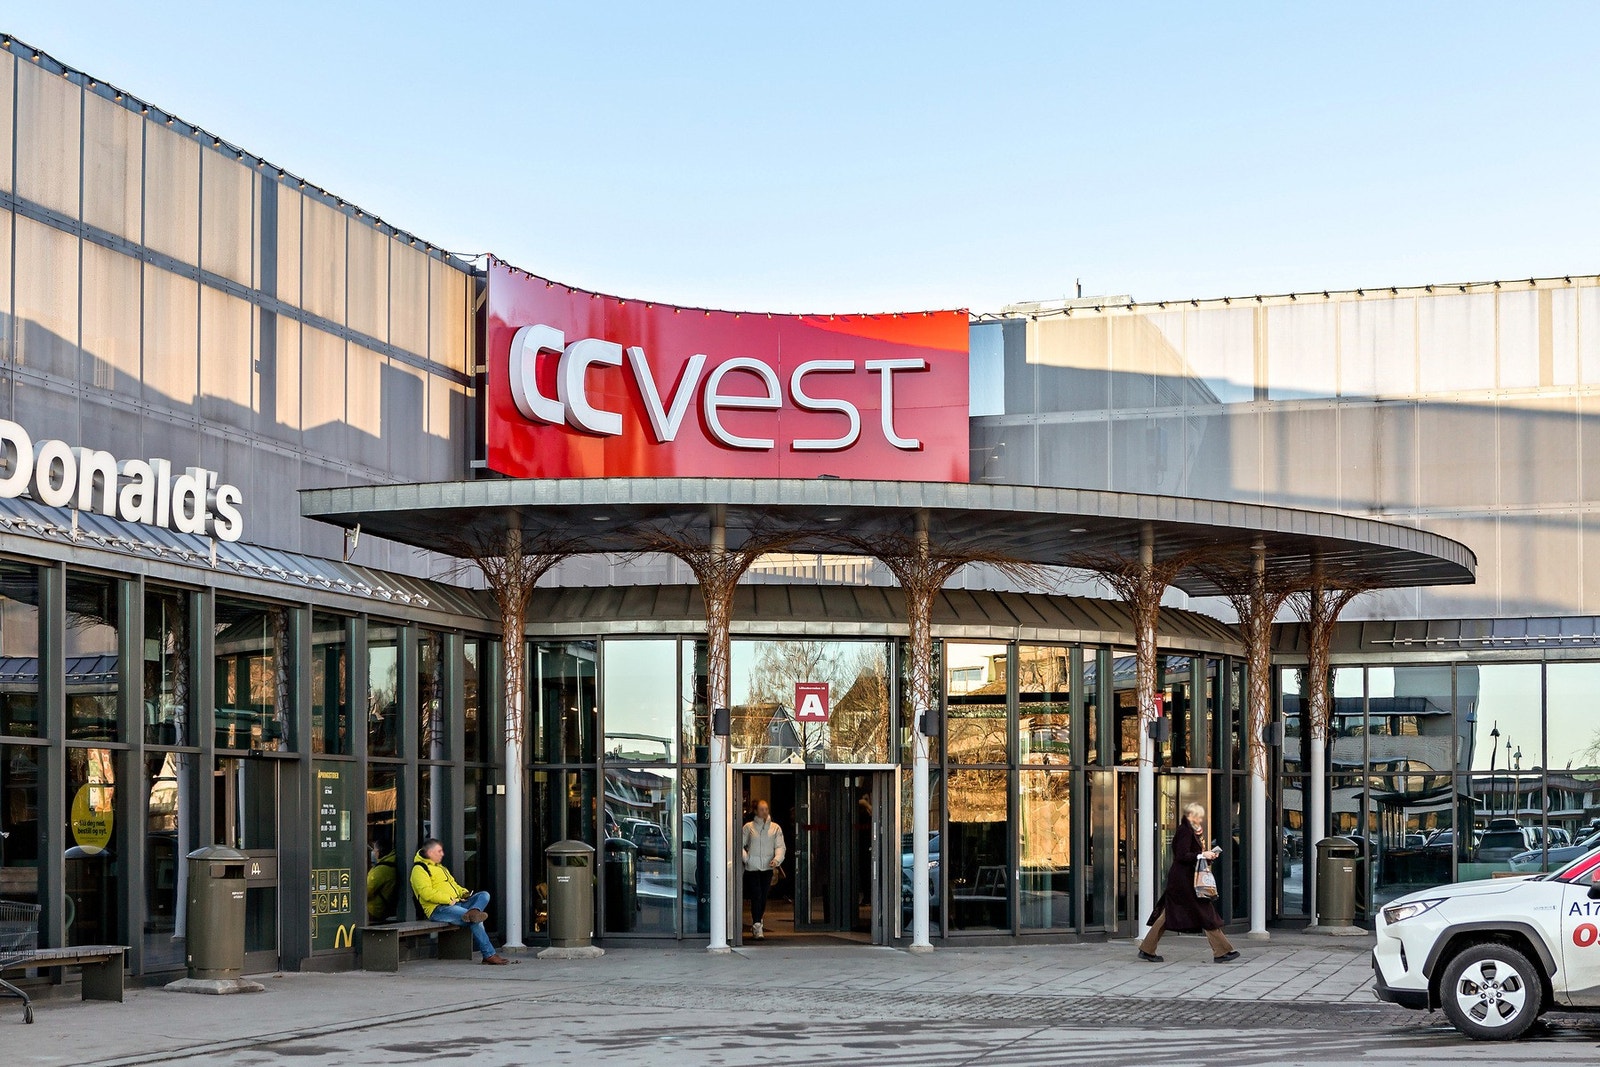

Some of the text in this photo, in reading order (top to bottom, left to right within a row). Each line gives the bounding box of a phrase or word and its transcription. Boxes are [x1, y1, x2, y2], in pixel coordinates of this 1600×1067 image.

[799, 694, 826, 717] A
[1569, 902, 1600, 916] A17
[1572, 922, 1600, 948] O
